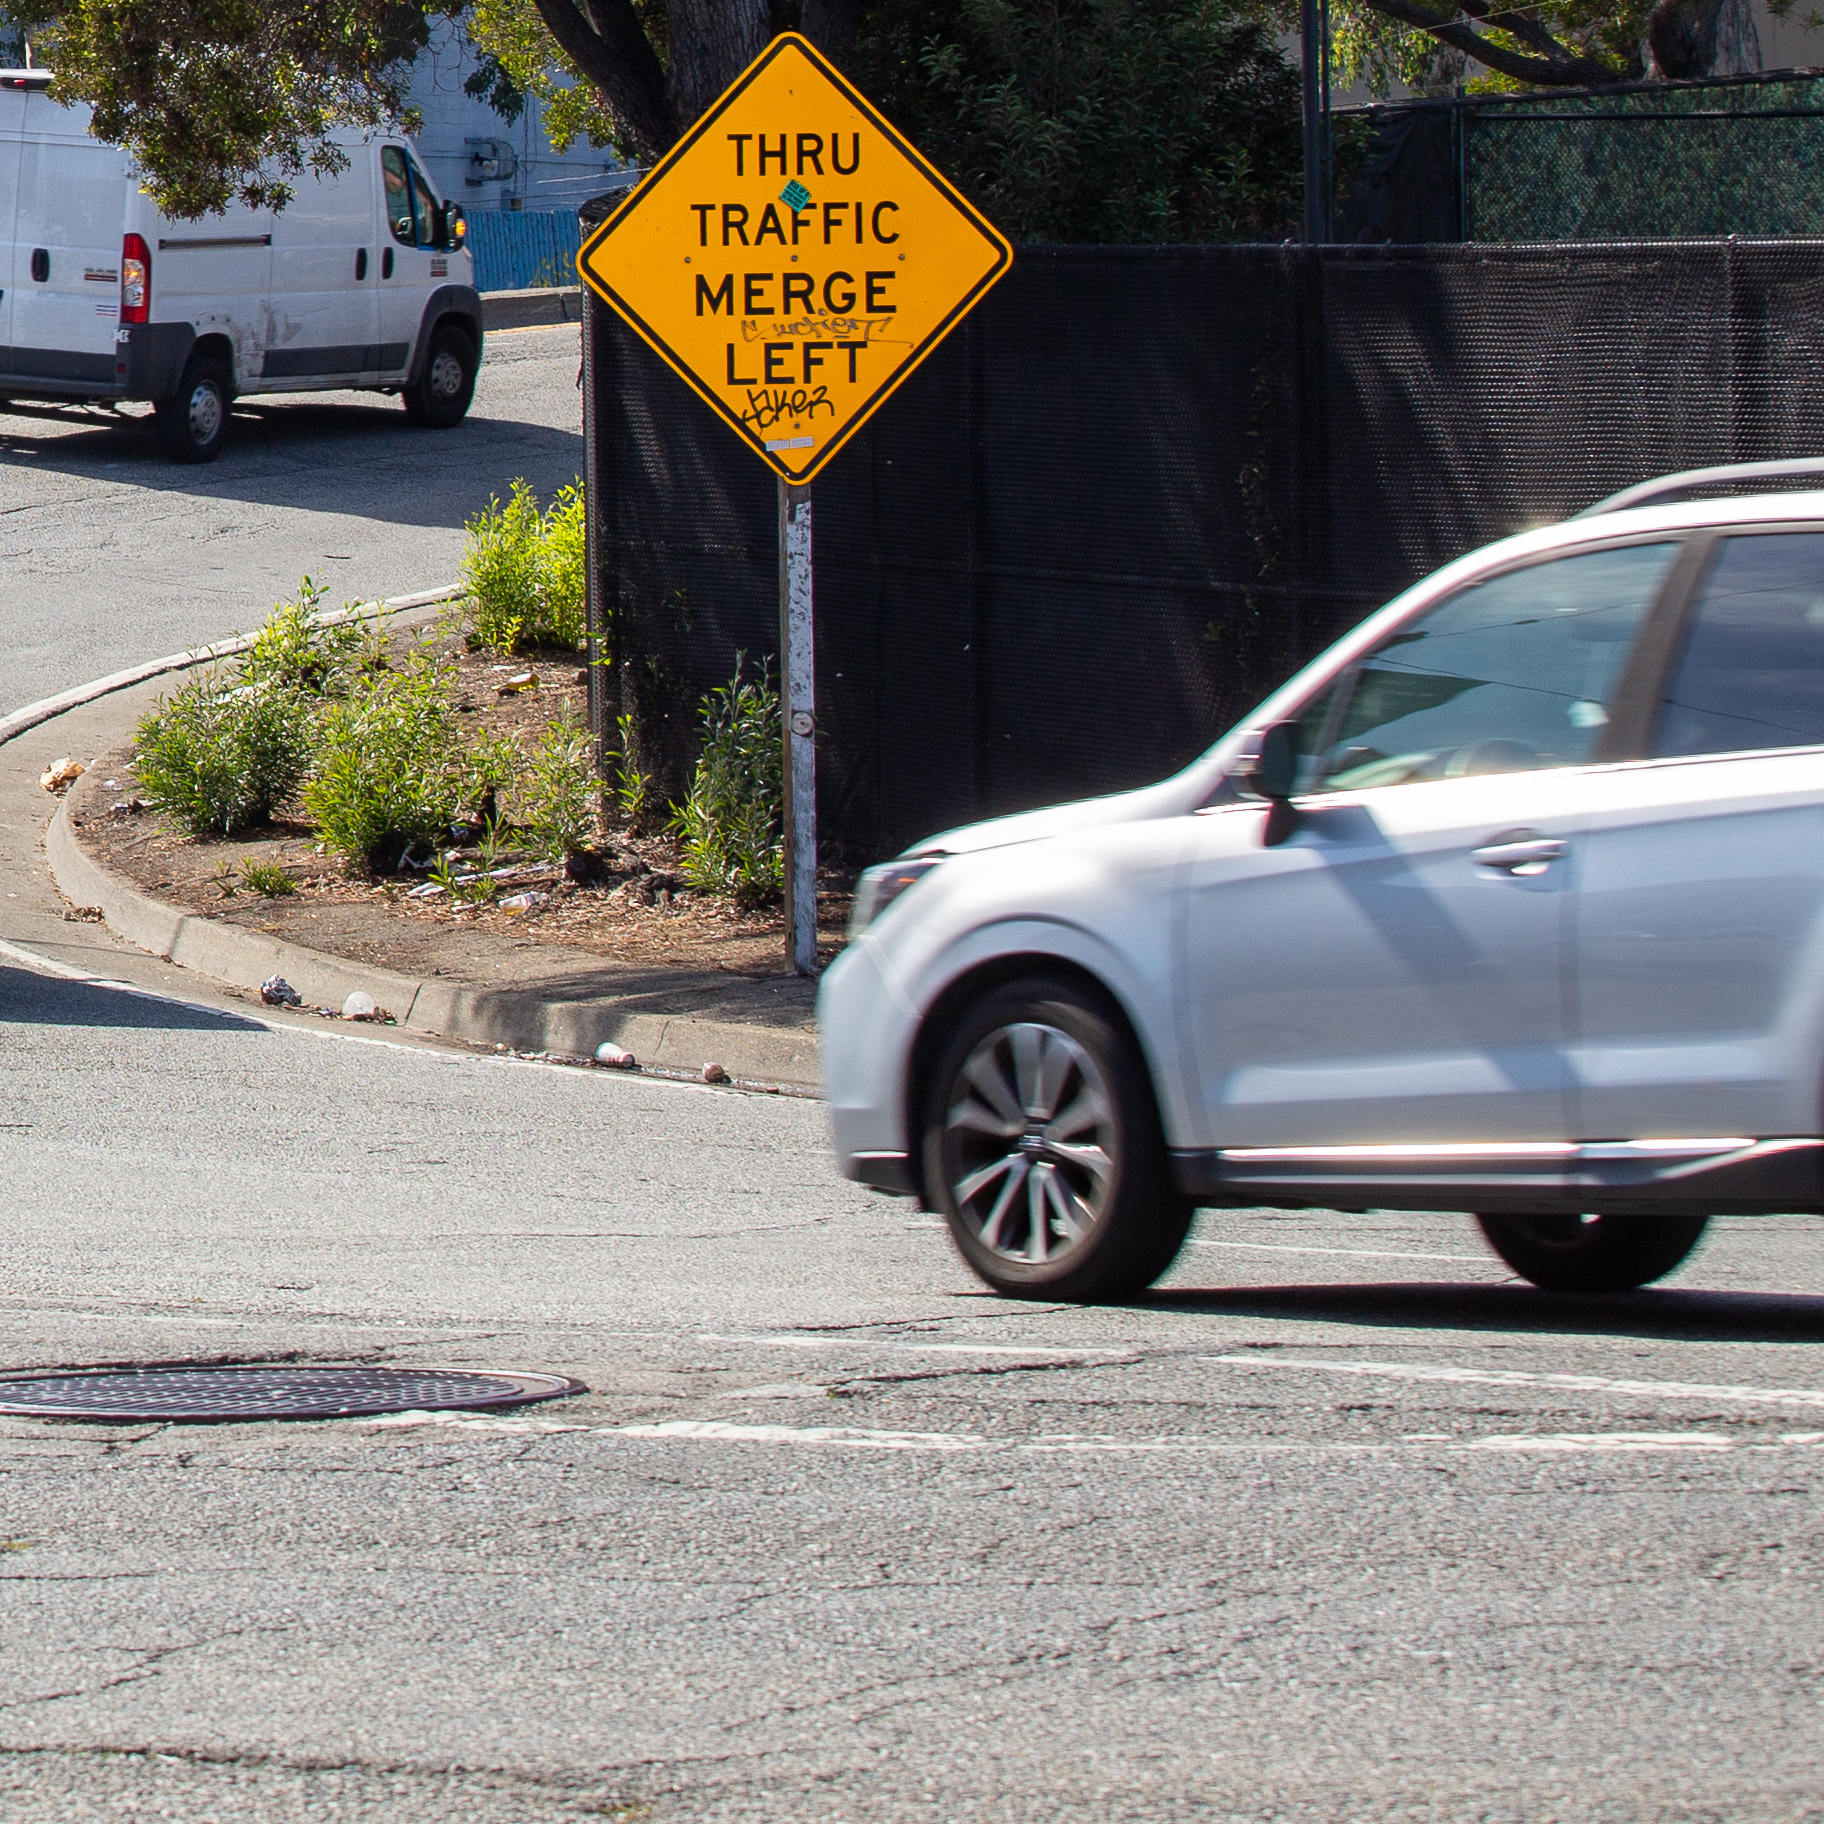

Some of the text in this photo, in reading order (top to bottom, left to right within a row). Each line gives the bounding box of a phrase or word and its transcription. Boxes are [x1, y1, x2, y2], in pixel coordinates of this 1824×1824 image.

[727, 132, 860, 176] THRU
[690, 200, 900, 247] TRAFFIC
[695, 271, 897, 316] MERGE
[727, 340, 867, 386] LEFT
